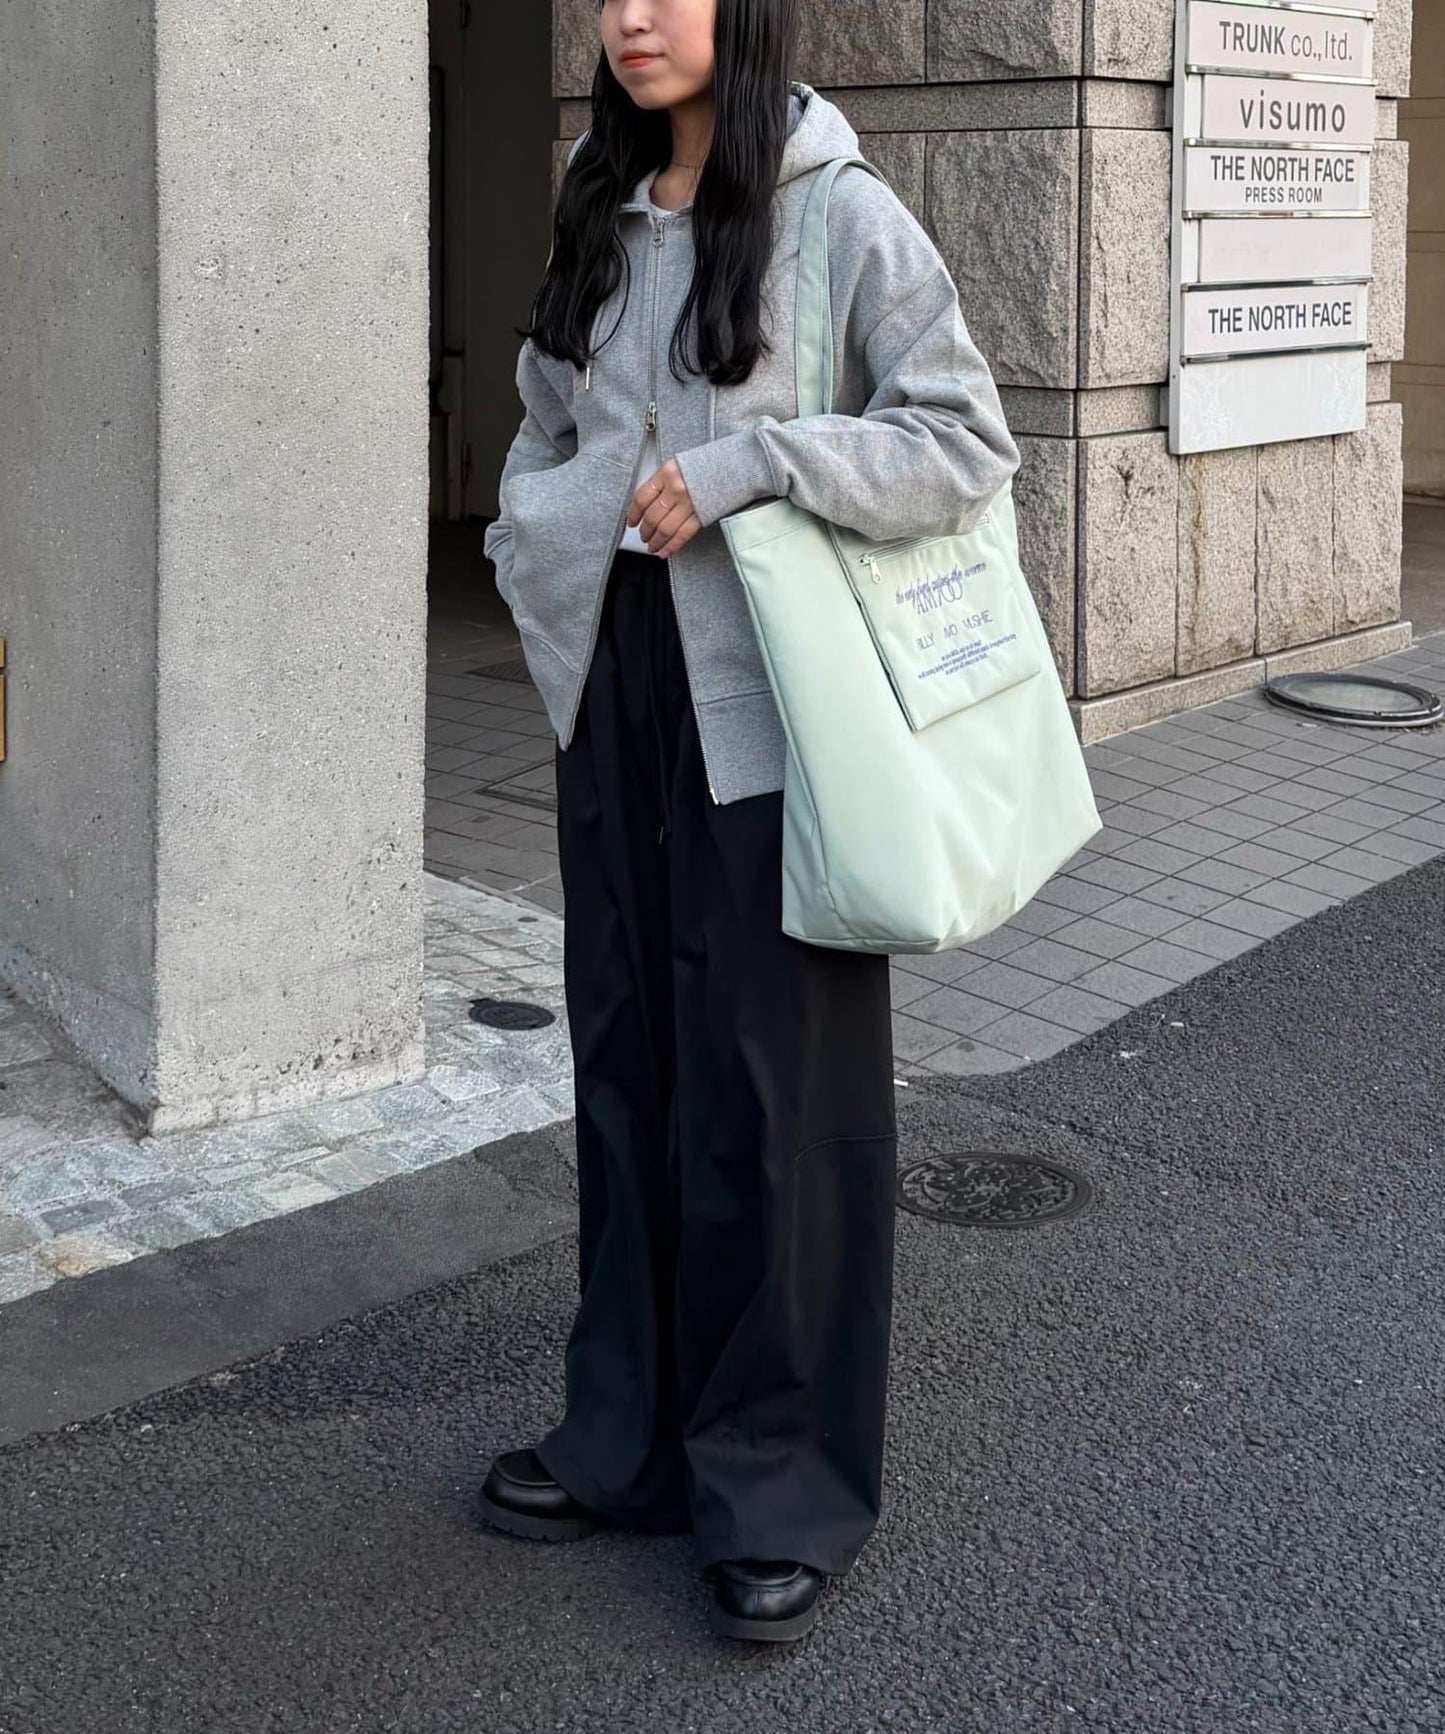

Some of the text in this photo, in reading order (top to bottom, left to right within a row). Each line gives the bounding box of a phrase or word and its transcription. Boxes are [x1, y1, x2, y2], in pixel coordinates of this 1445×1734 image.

[1219, 21, 1286, 55] TRUNK
[1240, 89, 1346, 133] visumo
[1210, 155, 1355, 182] THE NORTH FACE
[1245, 187, 1323, 203] PRESS ROOM
[1208, 301, 1352, 334] THE NORTH FACE
